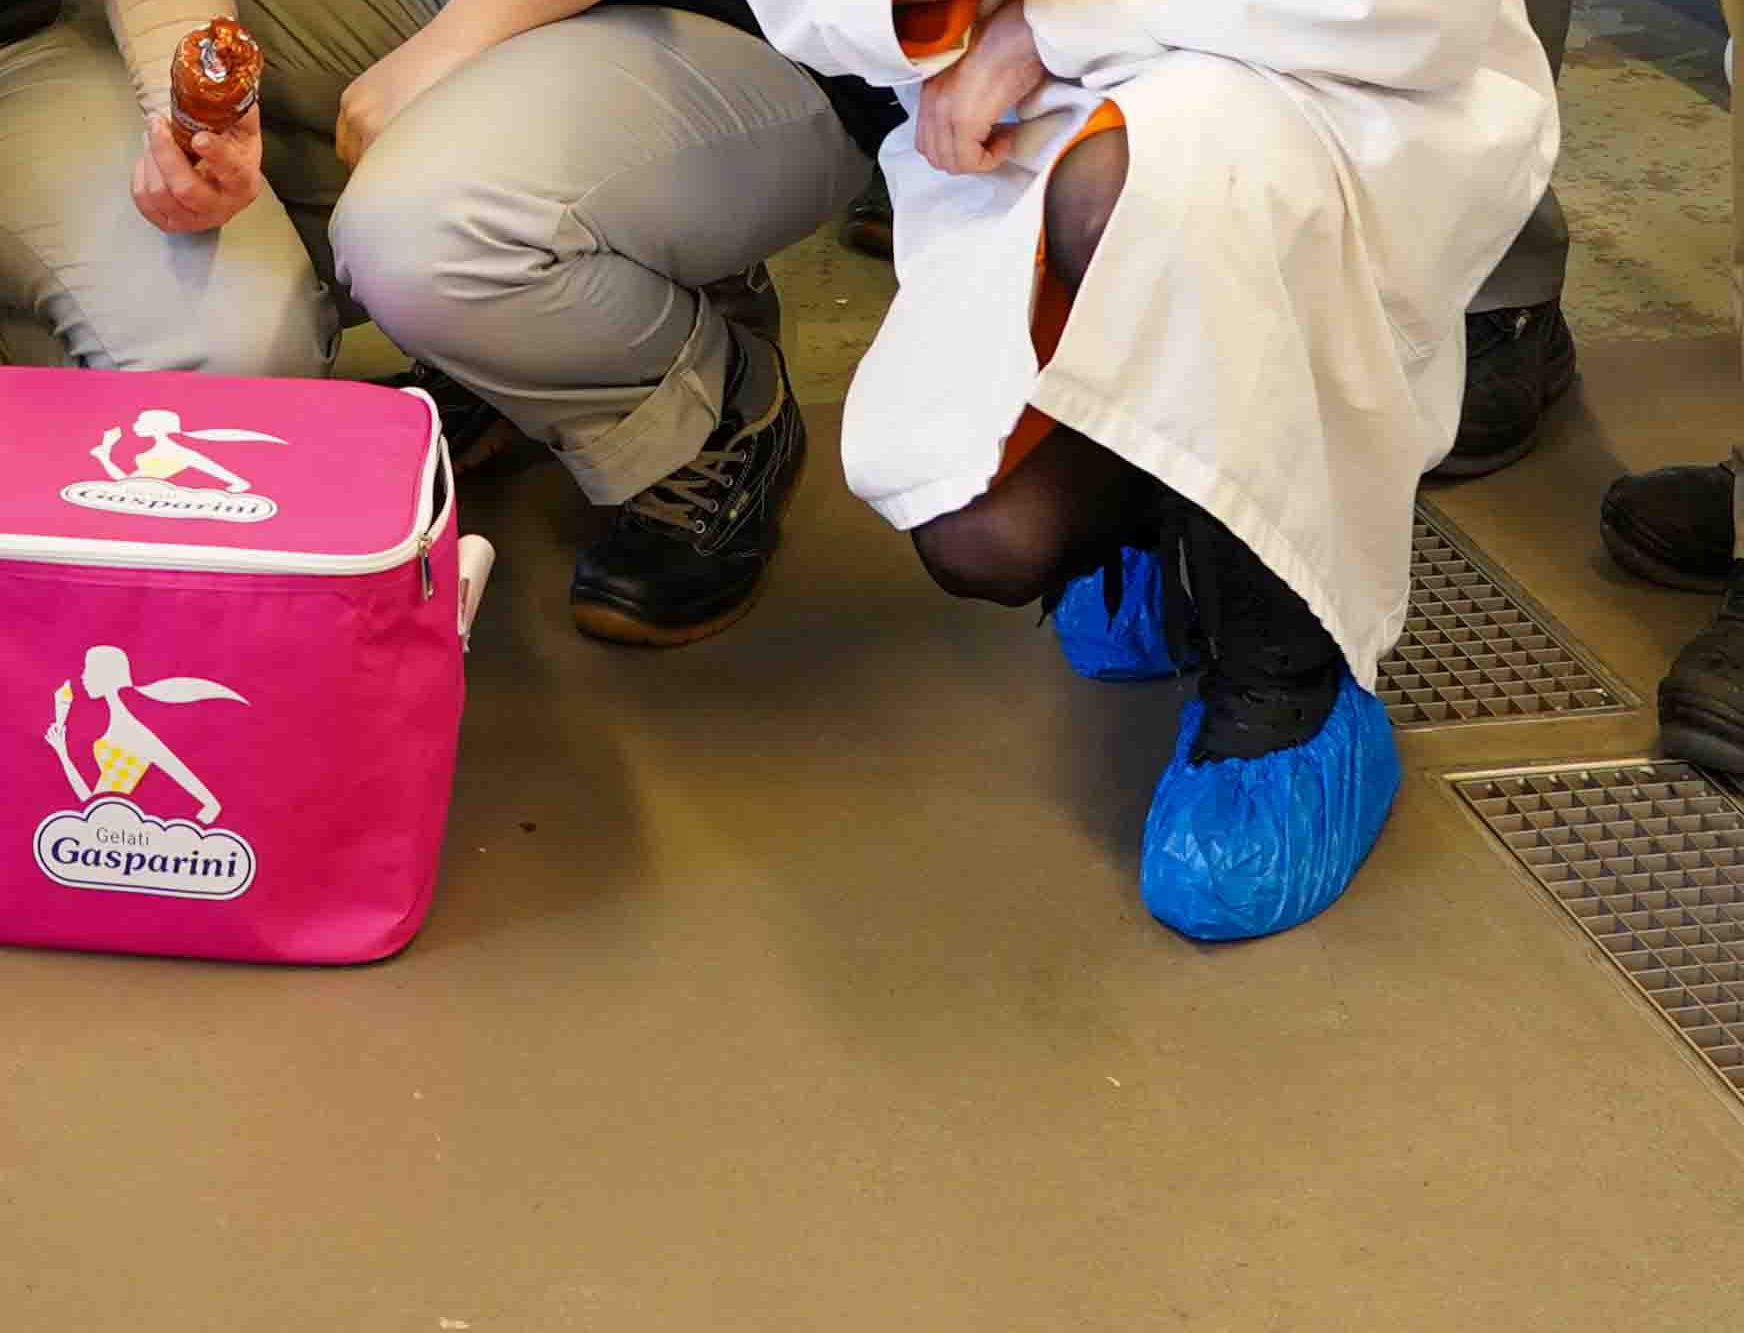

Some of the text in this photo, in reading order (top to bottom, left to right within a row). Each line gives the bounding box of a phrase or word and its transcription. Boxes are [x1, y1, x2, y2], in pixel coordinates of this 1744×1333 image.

[78, 489, 258, 515] Gasparini
[96, 827, 149, 846] Gelati
[51, 836, 238, 877] Gasparini
